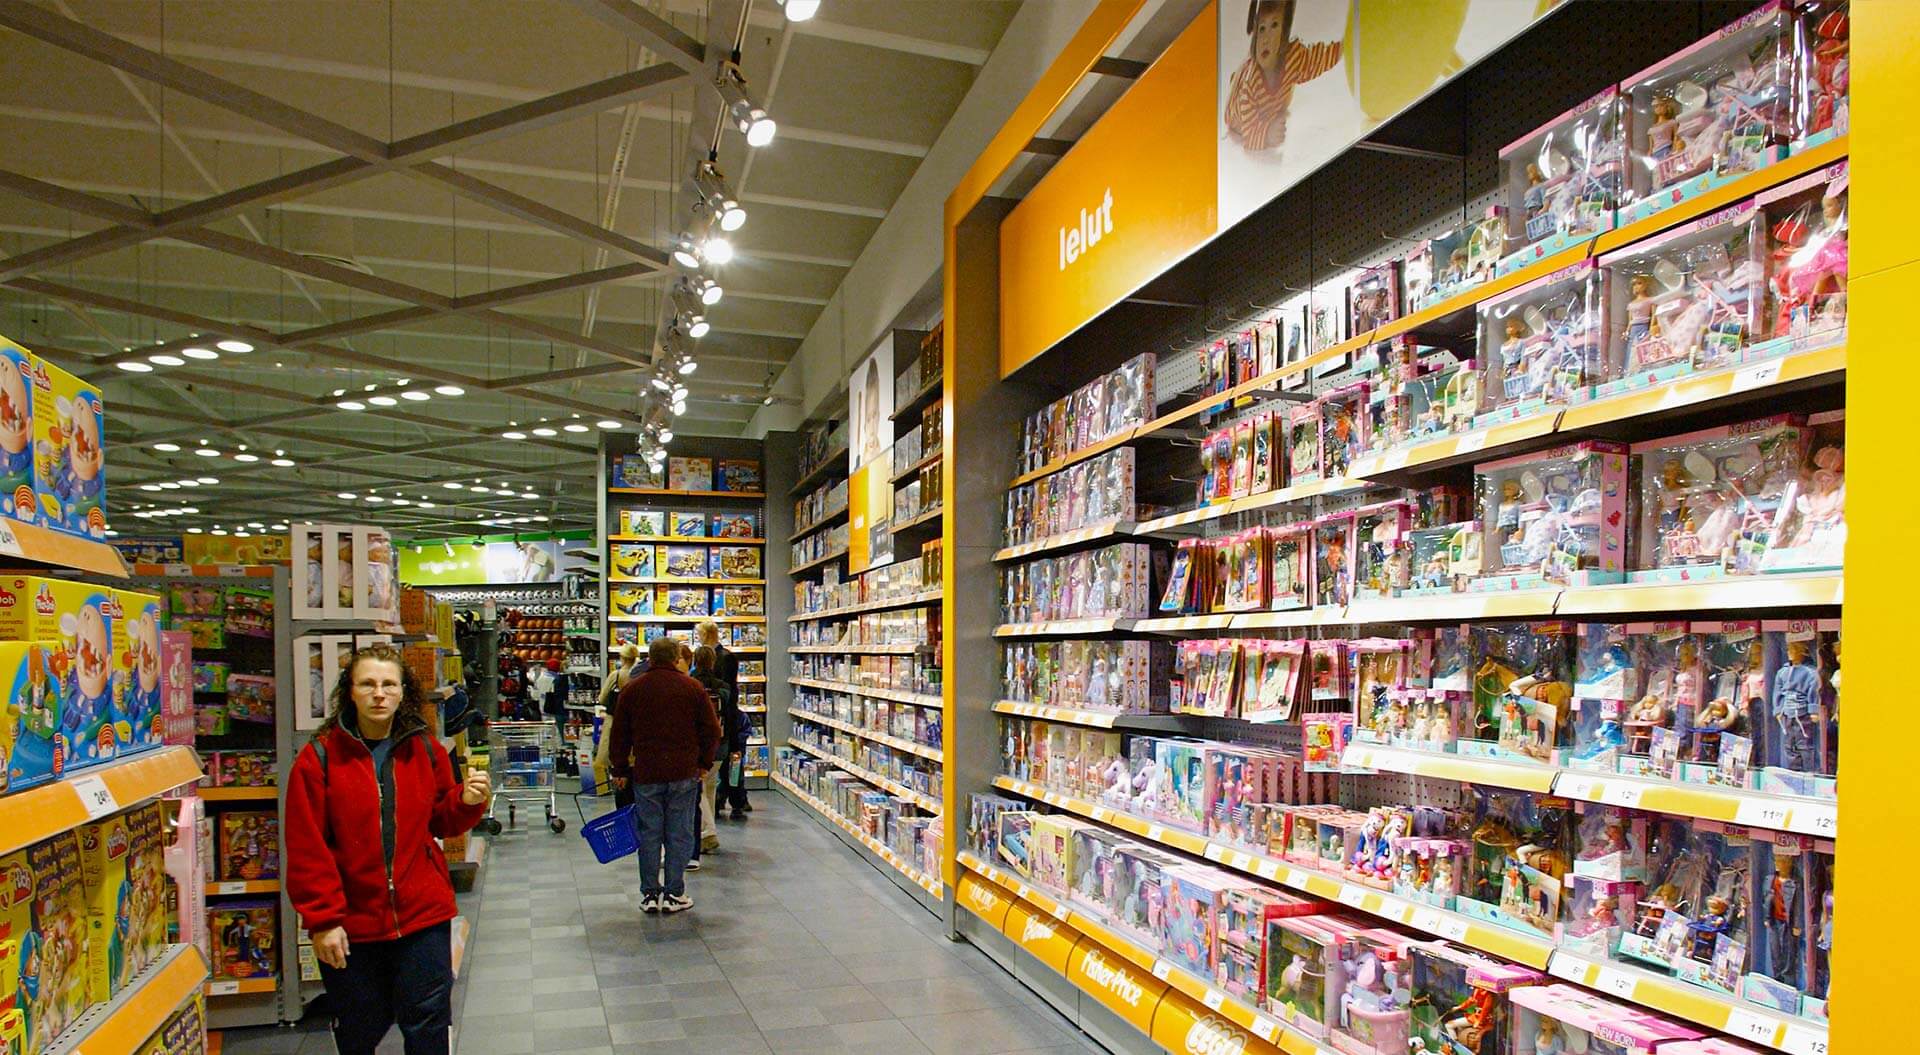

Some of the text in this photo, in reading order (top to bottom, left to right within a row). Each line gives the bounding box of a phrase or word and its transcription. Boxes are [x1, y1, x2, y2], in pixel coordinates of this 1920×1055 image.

[1721, 20, 1741, 39] NEW
[1059, 186, 1113, 271] lelut
[1698, 206, 1743, 230] NEW BORN
[1081, 949, 1143, 1007] Fisher-Price
